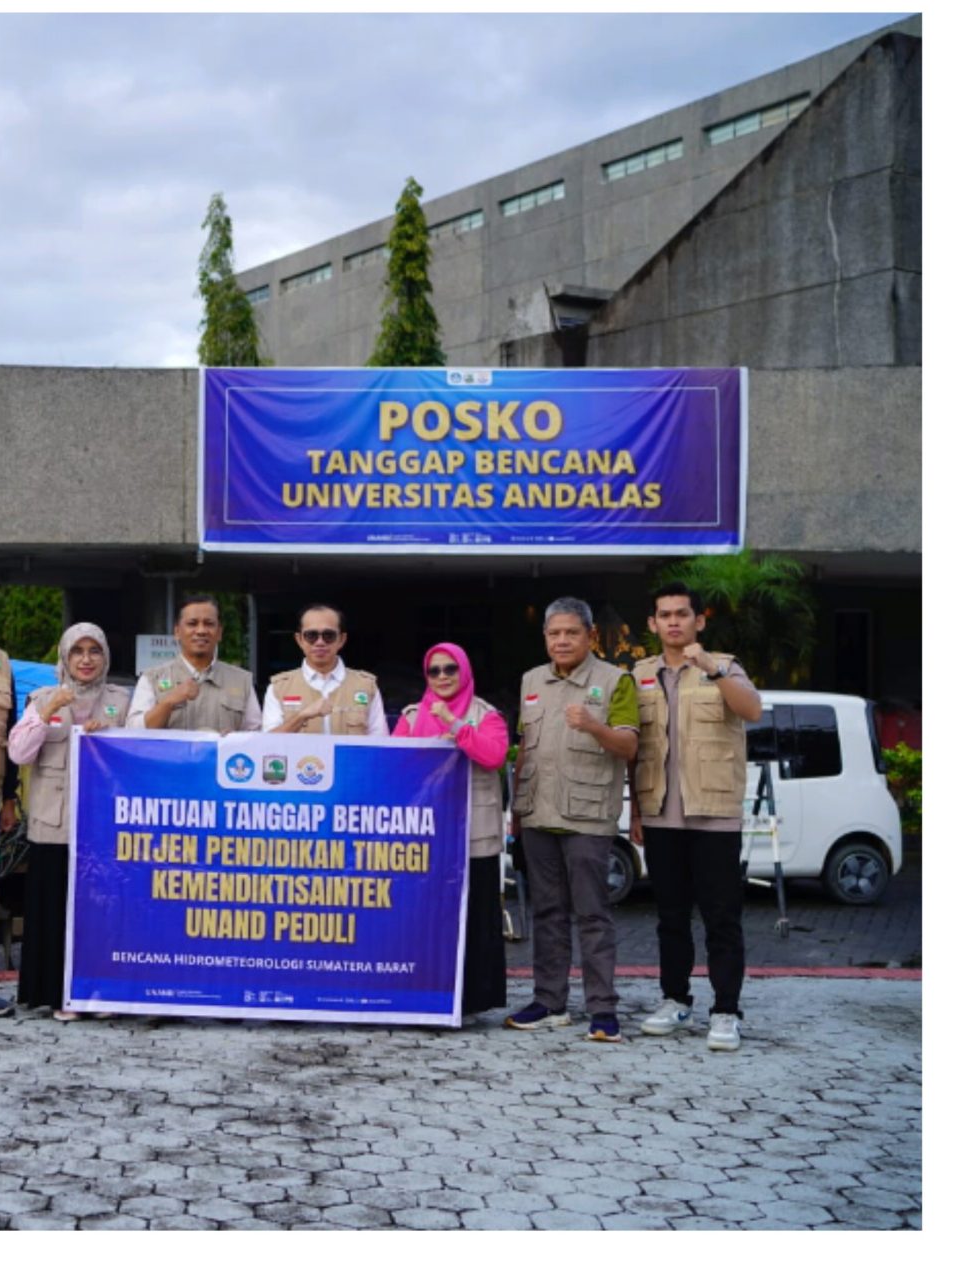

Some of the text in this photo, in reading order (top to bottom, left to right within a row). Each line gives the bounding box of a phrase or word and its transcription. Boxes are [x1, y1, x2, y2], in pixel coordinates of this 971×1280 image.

[379, 400, 563, 442] POSKO
[307, 449, 636, 475] TANGGAP BENCANA
[282, 482, 662, 509] UNIVERSITAS ANDALAS
[115, 796, 436, 836] BANTUAN TANGGAP BENCANA
[117, 831, 429, 872] DITJEN PENDIDIKAN TINGGI
[151, 869, 392, 909] KEMENDIKTISAINTEK
[185, 907, 356, 944] UNAND PEDULI
[112, 951, 417, 974] BENCANA HIDROMETEOROLOGI SUMATERA BARAT
